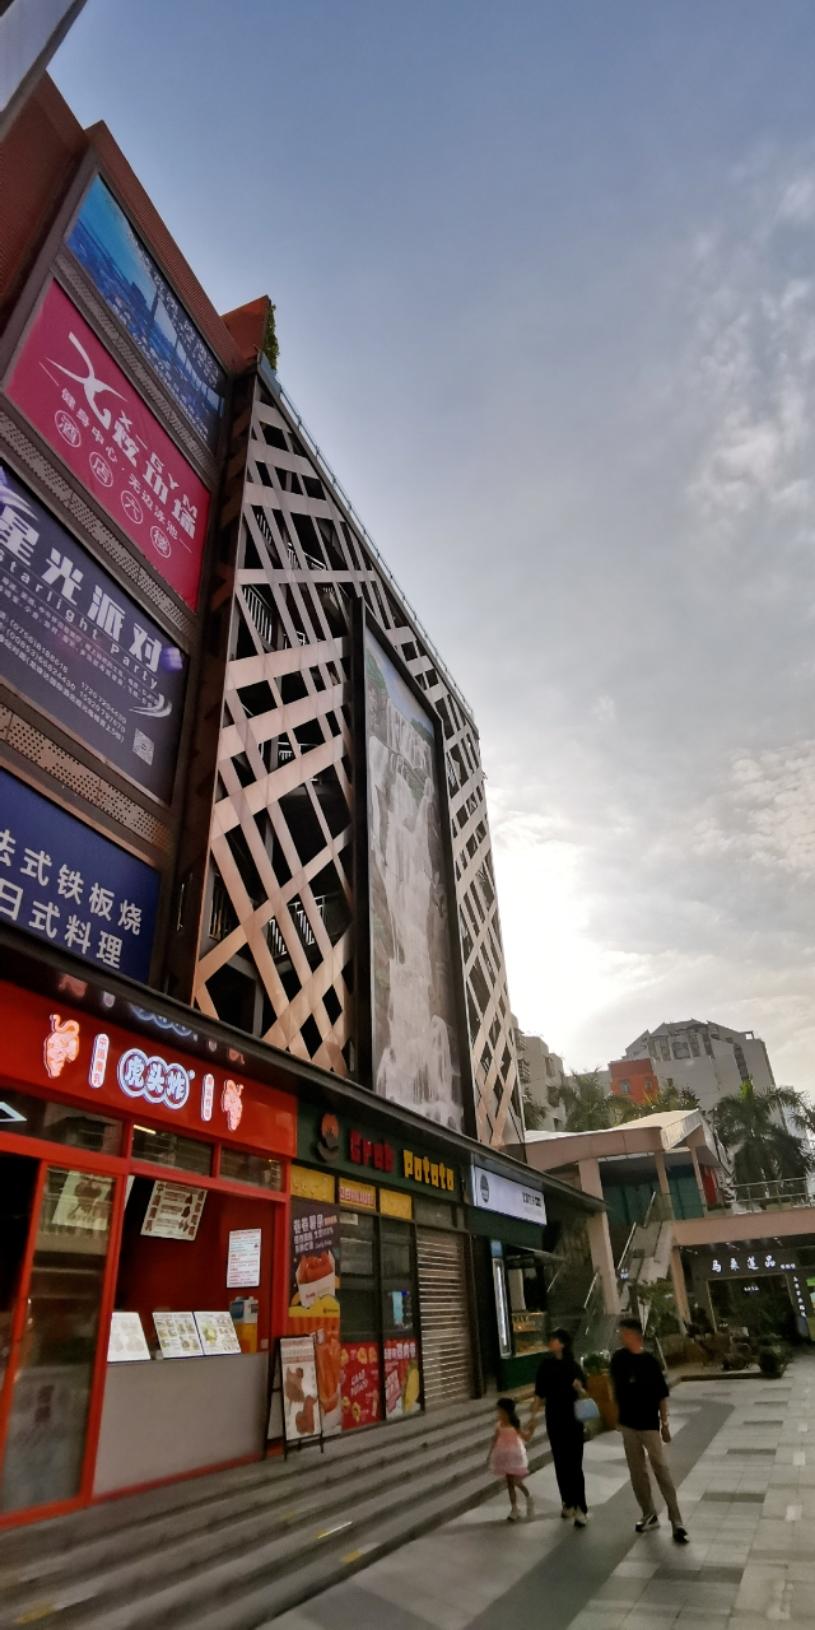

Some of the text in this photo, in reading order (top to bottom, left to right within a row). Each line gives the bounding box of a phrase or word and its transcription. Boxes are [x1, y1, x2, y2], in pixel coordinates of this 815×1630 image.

[0, 506, 162, 673] 星光派对
[111, 643, 157, 690] Party
[0, 829, 142, 936] 法式铁板烧
[0, 878, 123, 969] 日式料理
[121, 1053, 188, 1102] 虎头炸
[403, 1149, 455, 1192] Potato
